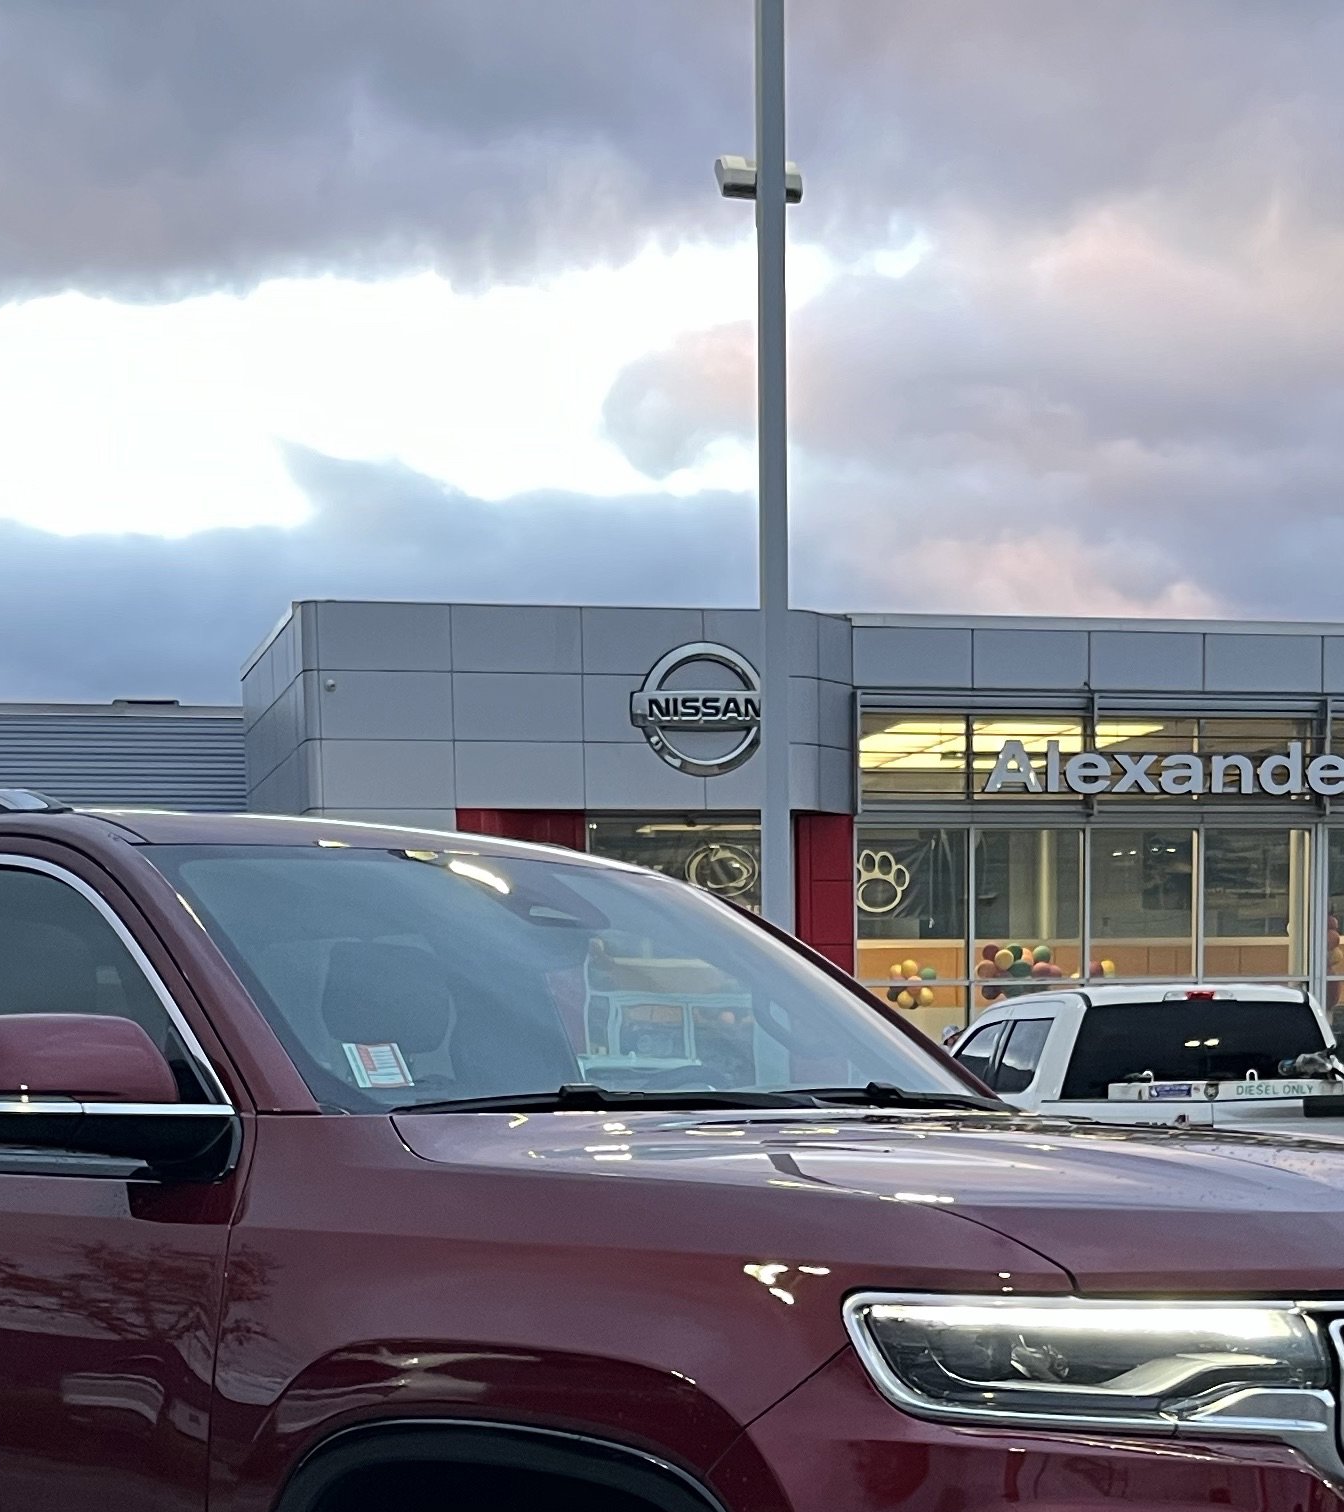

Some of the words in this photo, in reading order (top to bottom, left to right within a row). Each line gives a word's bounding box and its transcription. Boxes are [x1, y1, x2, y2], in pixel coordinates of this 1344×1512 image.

[648, 697, 760, 720] NISSAN
[1236, 1084, 1278, 1096] DIESEL
[1282, 1083, 1314, 1095] ONLY
